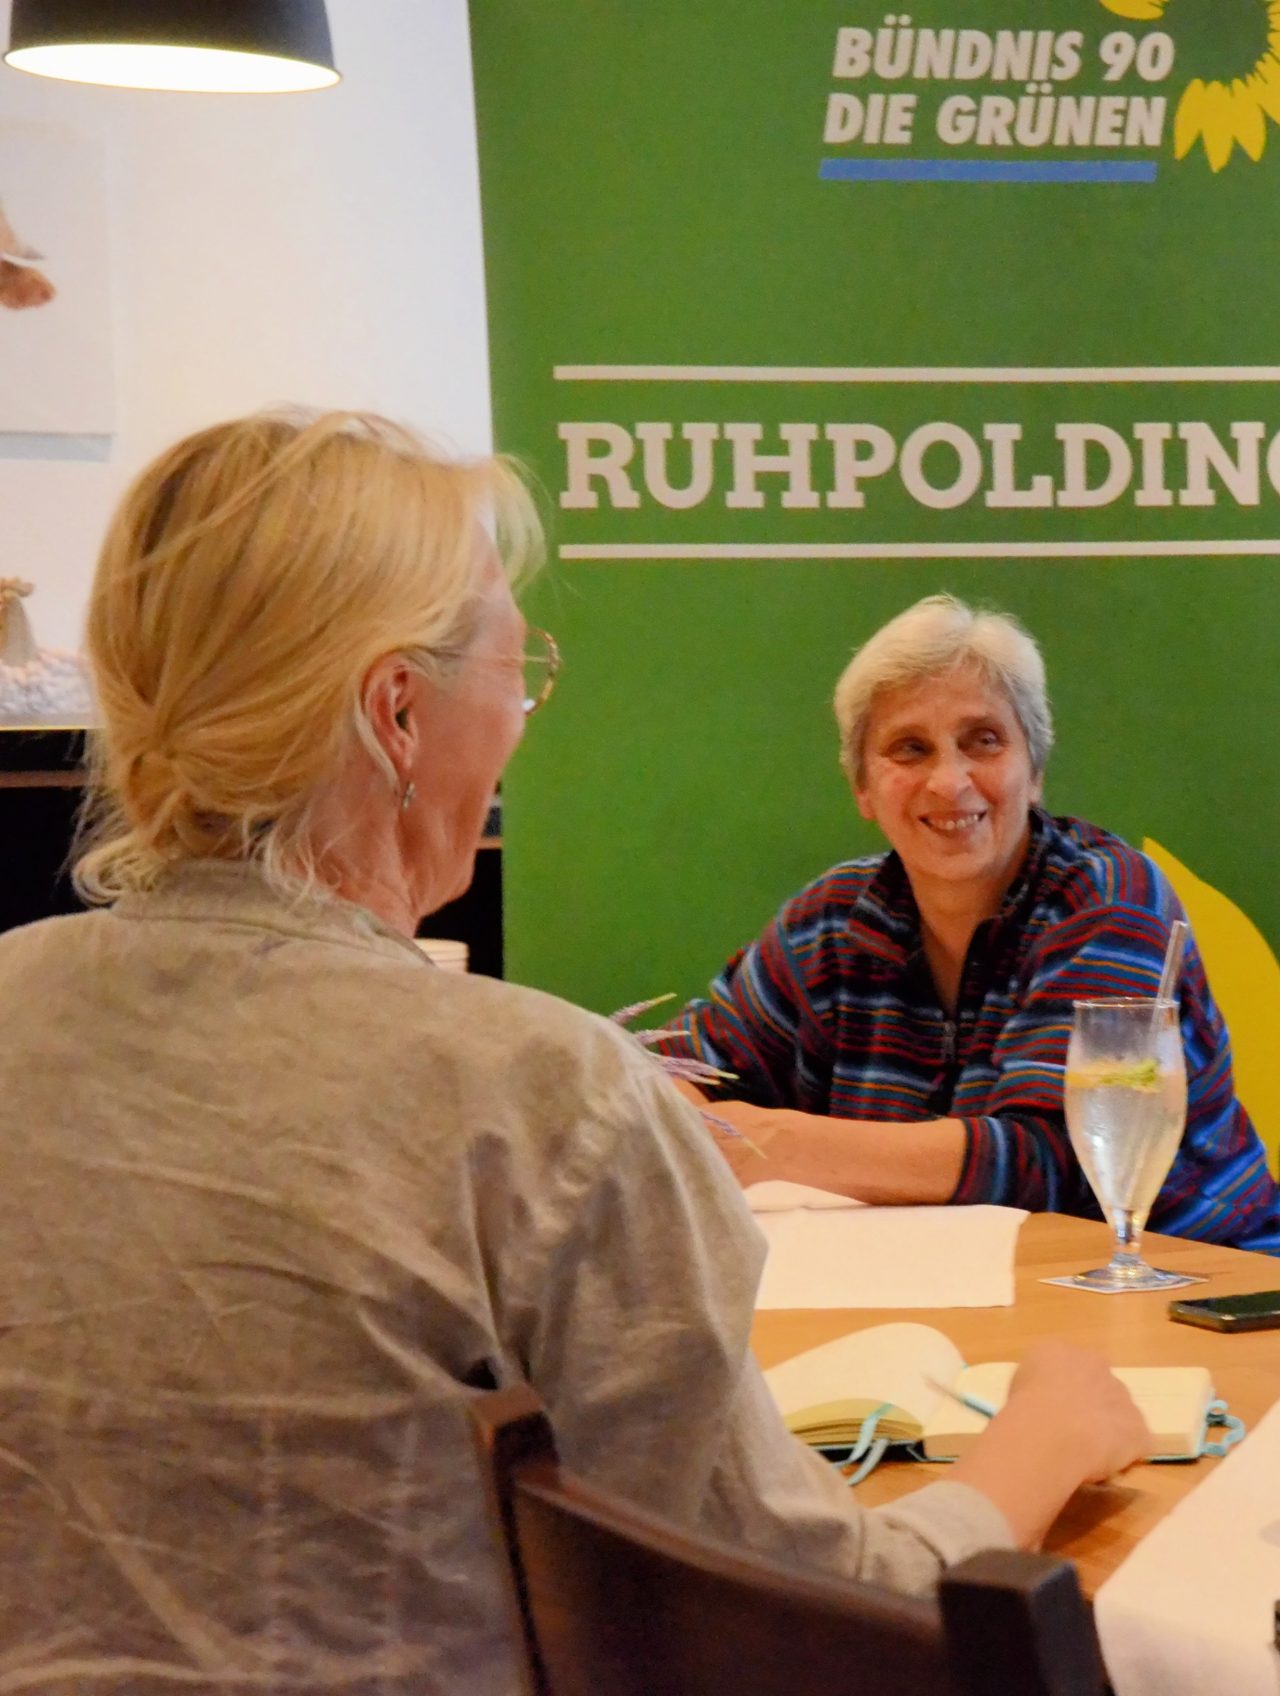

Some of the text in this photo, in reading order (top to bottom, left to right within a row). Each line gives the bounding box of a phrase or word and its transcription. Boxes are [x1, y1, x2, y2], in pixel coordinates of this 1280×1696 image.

[832, 14, 1174, 81] BÜNDNIS 90
[823, 82, 1166, 147] DIE GRÜNEN
